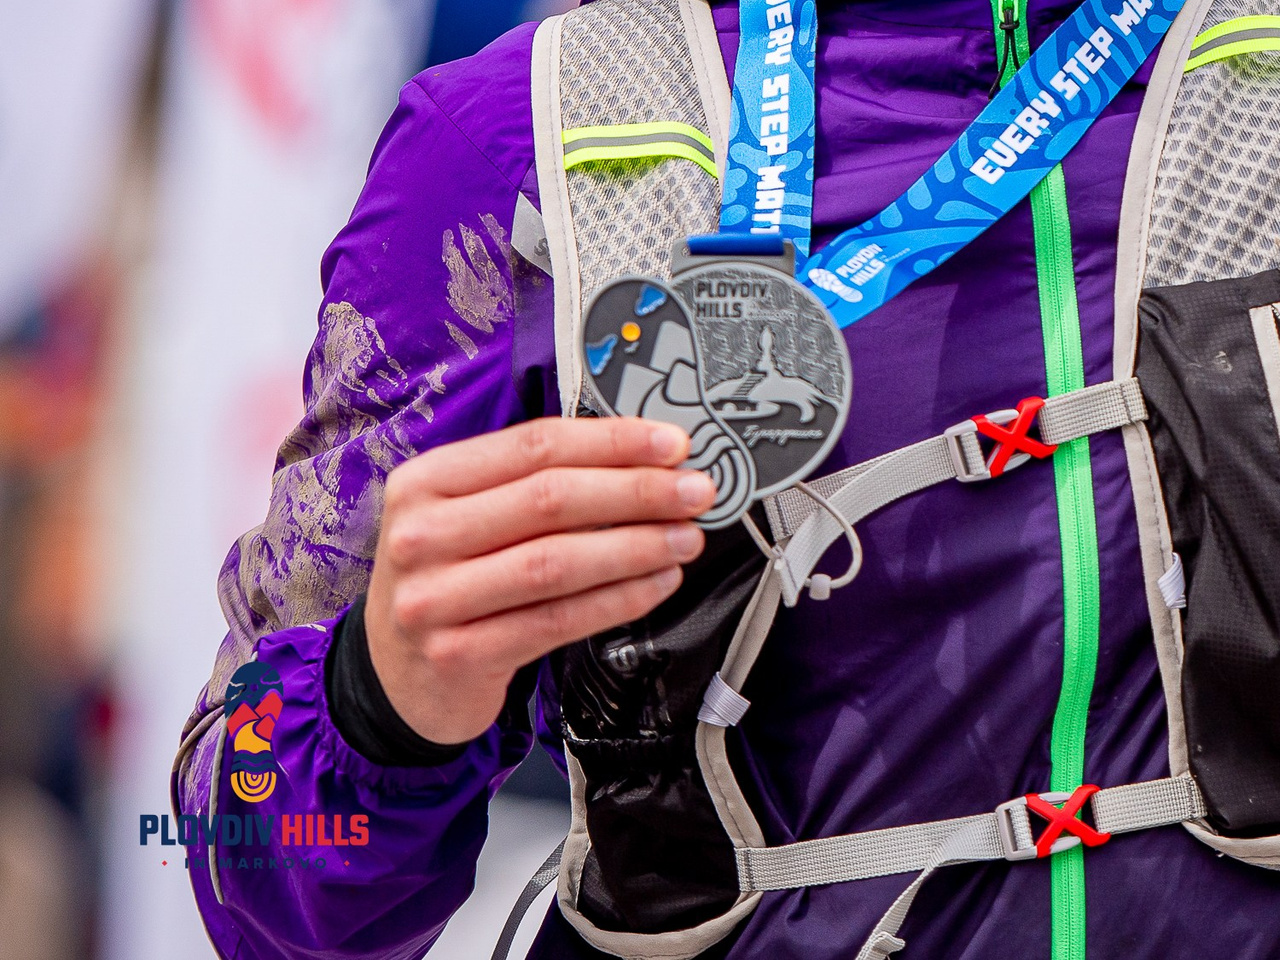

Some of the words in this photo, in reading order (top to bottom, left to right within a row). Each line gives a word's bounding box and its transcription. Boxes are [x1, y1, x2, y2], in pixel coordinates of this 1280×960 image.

[1049, 26, 1114, 102] STEP
[760, 73, 789, 156] STEP
[835, 243, 883, 279] PLOVDIV
[849, 258, 886, 286] HILLS
[696, 281, 767, 298] PLOVDIV
[696, 302, 742, 318] HILLS
